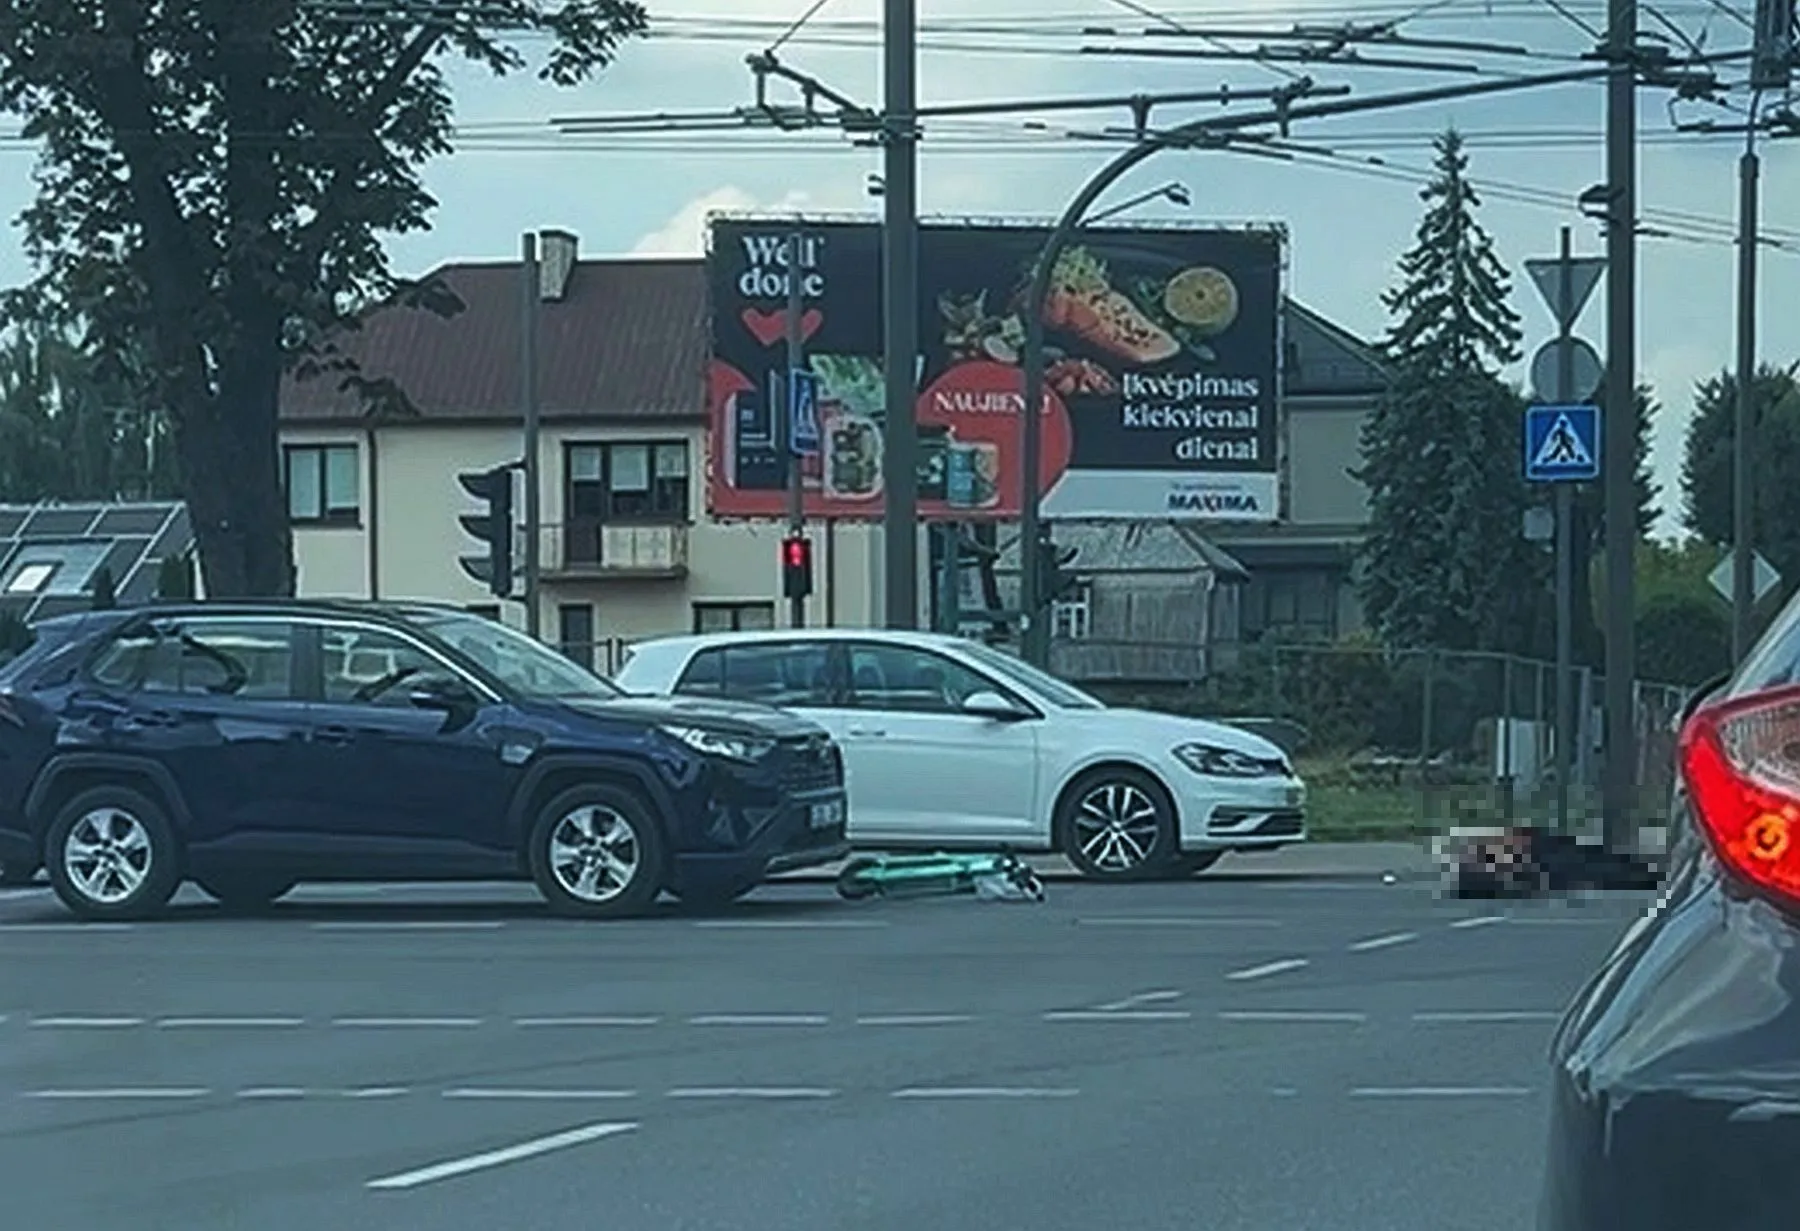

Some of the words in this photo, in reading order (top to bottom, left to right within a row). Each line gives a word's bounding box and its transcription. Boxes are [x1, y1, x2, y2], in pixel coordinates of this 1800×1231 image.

[1123, 404, 1258, 428] kiekvienai
[1176, 437, 1258, 459] dienai
[1168, 494, 1258, 512] MAXIMA
